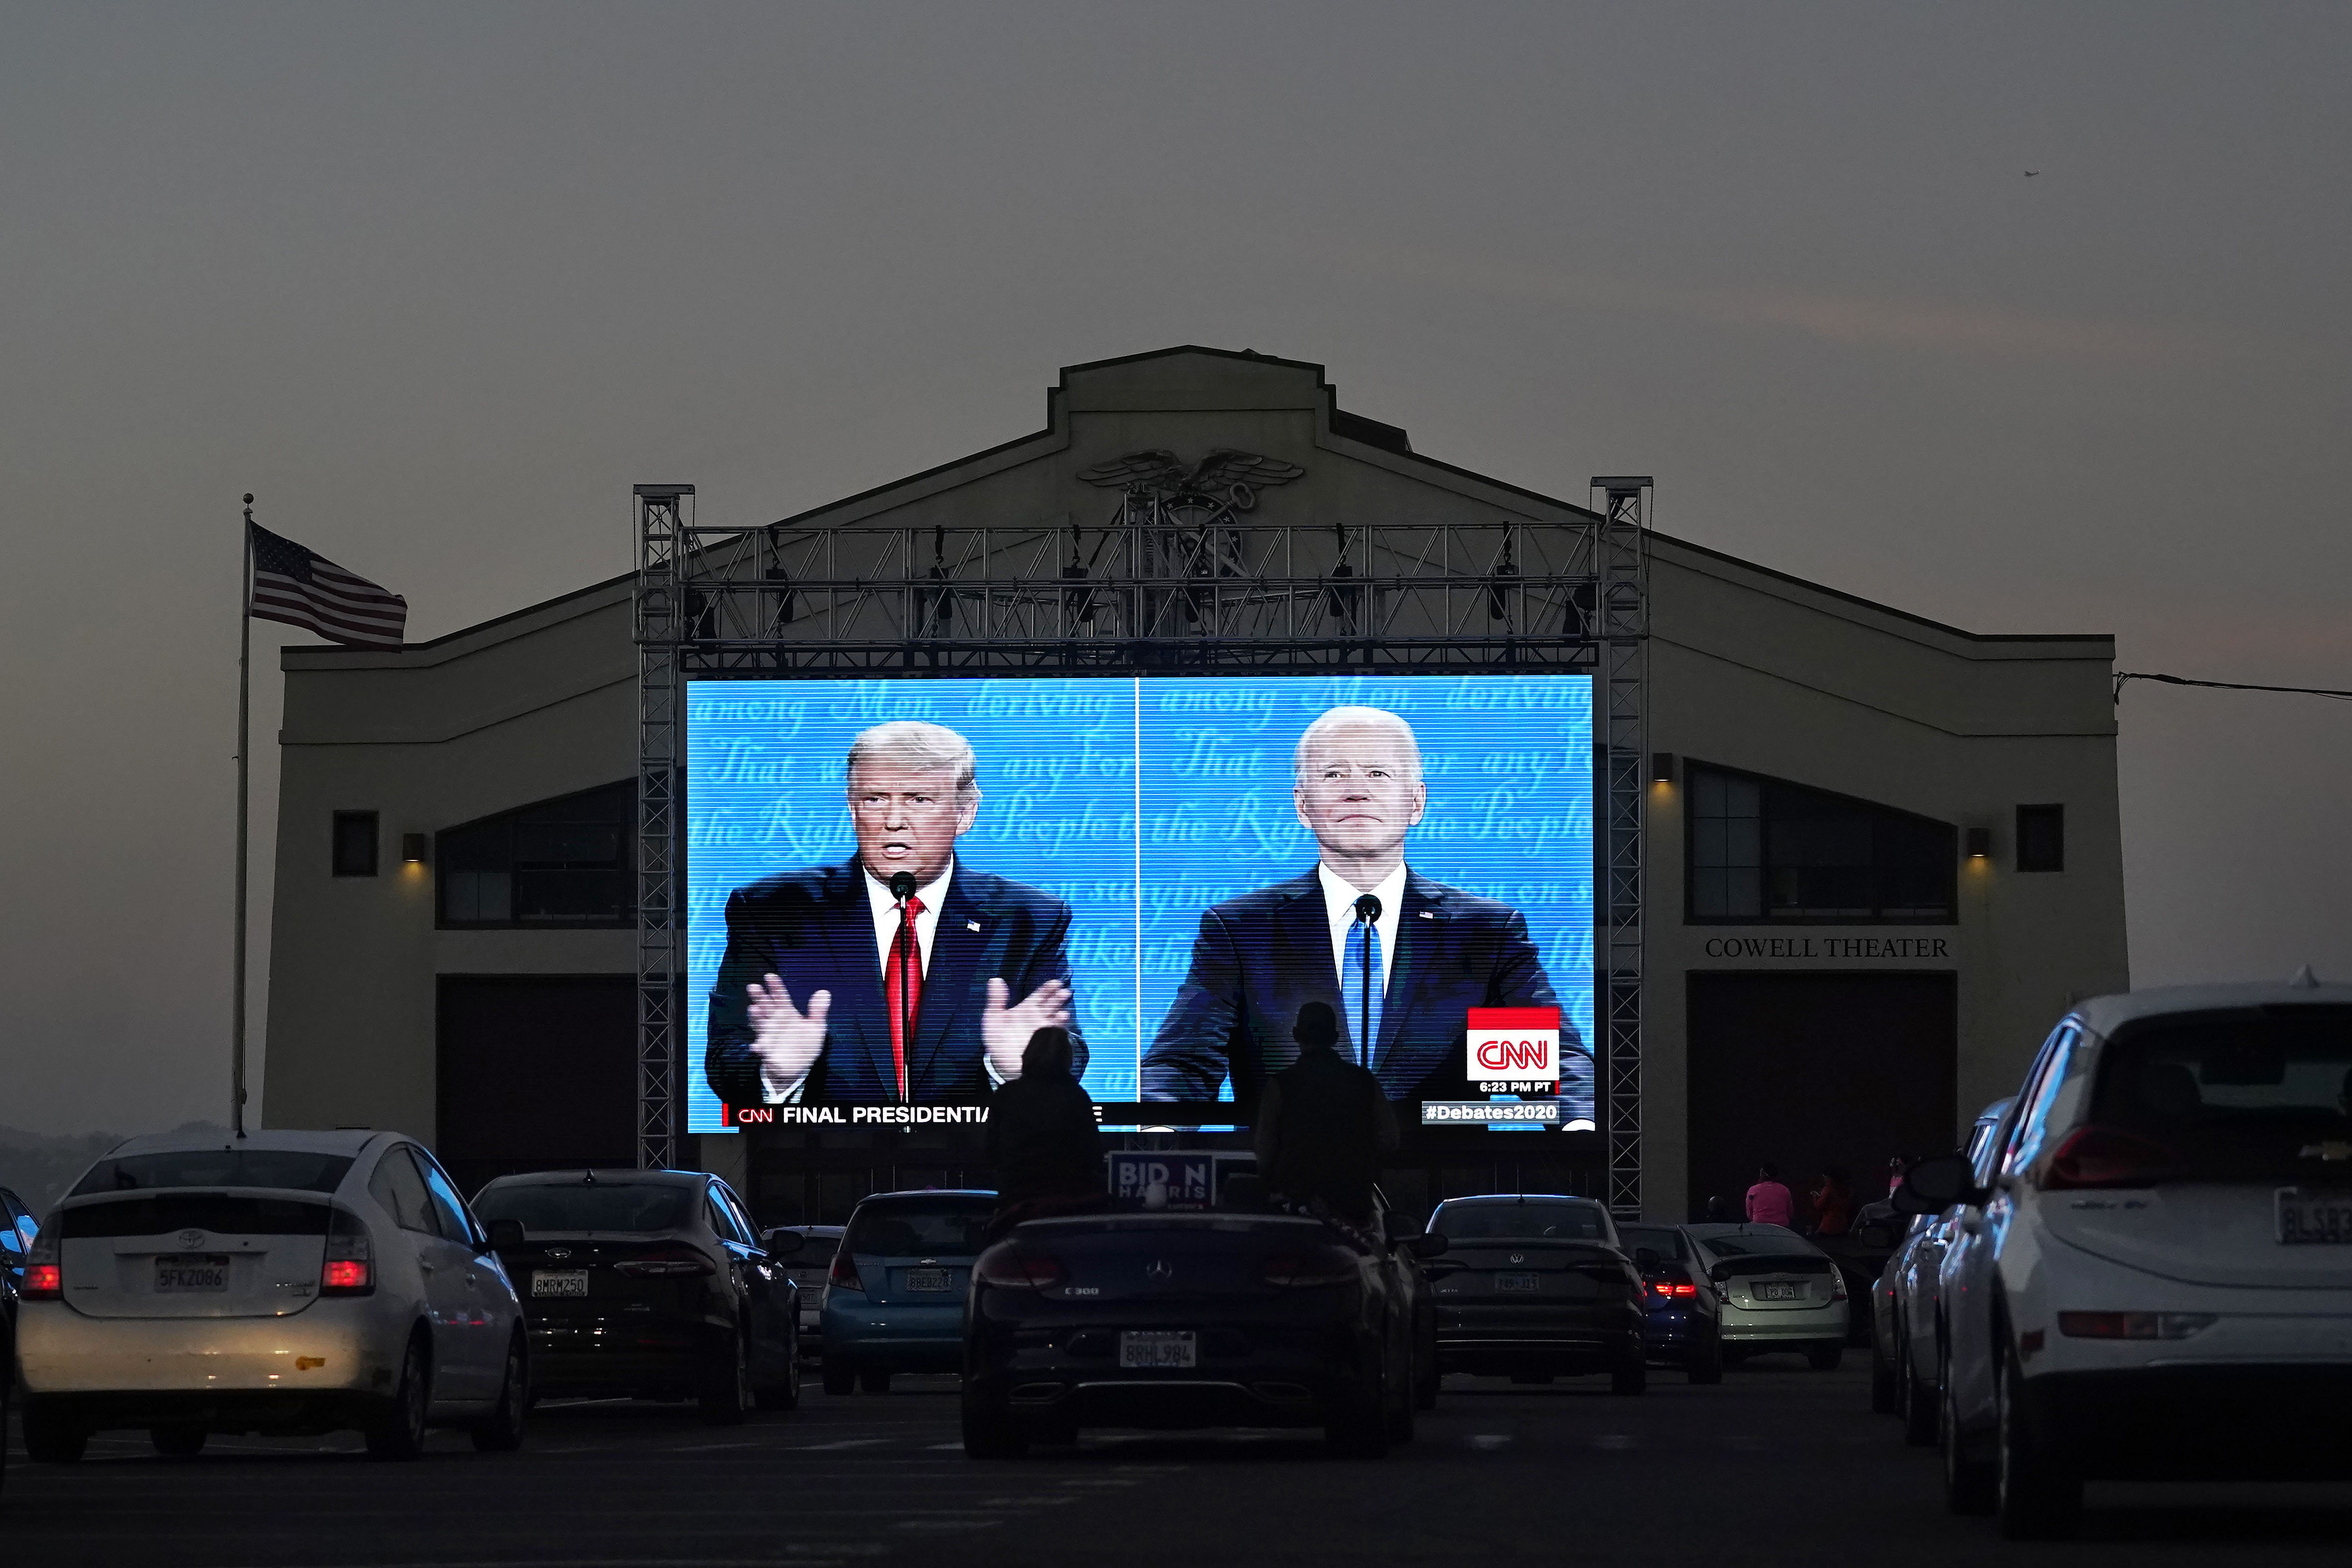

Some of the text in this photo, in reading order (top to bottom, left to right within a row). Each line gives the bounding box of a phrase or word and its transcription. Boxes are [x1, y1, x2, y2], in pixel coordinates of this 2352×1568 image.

[1706, 939, 1949, 957] COWELL THEATER
[1477, 1041, 1547, 1070] CNN
[1480, 1082, 1551, 1092] 6:23 PM PT
[737, 1108, 773, 1123] CNN
[783, 1107, 846, 1123] FINAL
[1426, 1105, 1557, 1119] #Debates2020
[1119, 1162, 1205, 1186] BIDN
[1119, 1185, 1206, 1199] HARIS
[537, 1279, 583, 1292] 8MRM250
